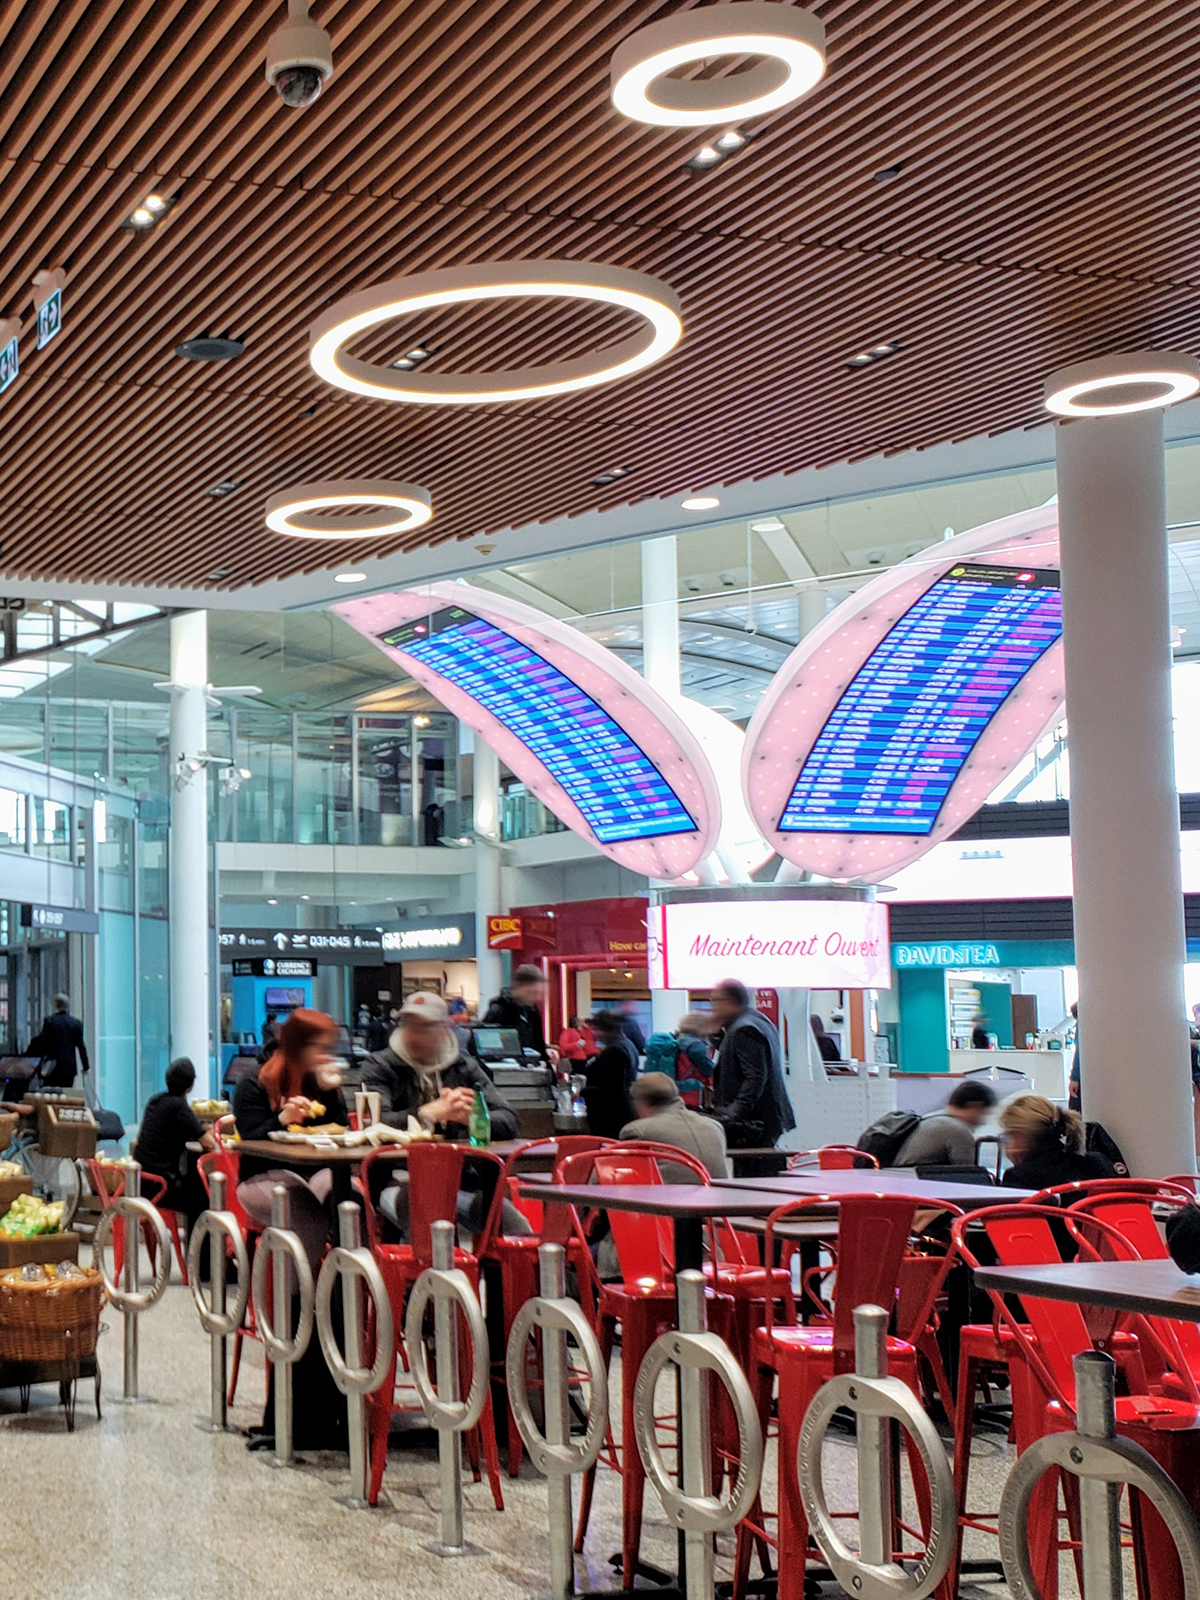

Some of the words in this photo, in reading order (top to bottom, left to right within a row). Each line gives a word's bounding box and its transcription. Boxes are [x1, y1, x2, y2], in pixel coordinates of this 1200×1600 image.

[490, 919, 520, 931] CIBC
[309, 935, 351, 948] D31-D45
[609, 941, 633, 951] How
[689, 934, 819, 957] Maintenant
[824, 932, 880, 957] Ouvert
